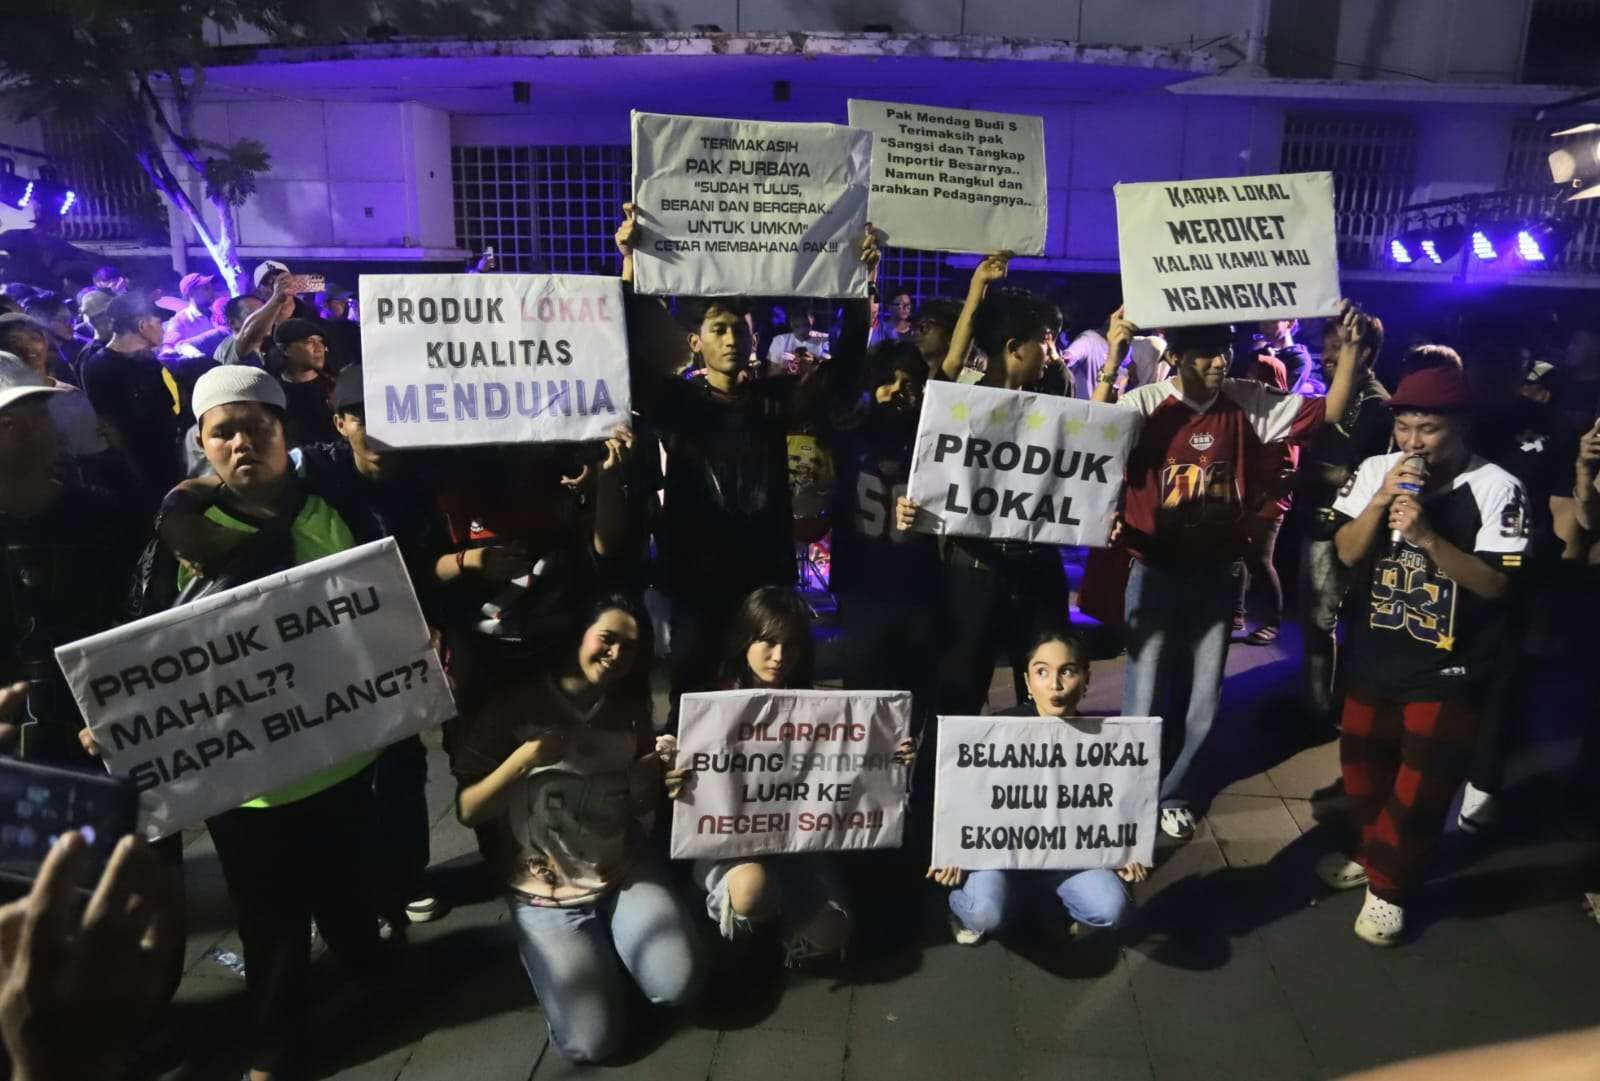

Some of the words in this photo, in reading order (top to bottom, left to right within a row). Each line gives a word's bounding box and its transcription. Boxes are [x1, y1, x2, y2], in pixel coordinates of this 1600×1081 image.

[887, 109, 912, 120] Pak
[917, 112, 970, 128] Mendag
[975, 119, 1004, 130] Budi
[1009, 122, 1017, 131] S
[701, 137, 798, 152] TERIMAKASIH
[899, 125, 974, 141] Terimaksih
[979, 134, 1003, 145] pak
[888, 153, 944, 167] Importir
[949, 159, 1019, 175] Besarnya..
[939, 144, 963, 155] dan
[968, 147, 1025, 163] Tangkap
[686, 159, 722, 174] PAK
[729, 161, 810, 177] PURBAYA
[886, 168, 934, 181] Namun
[939, 173, 994, 187] Rangkul
[999, 180, 1023, 190] dan
[754, 183, 801, 197] TULUS,
[872, 184, 928, 197] arahkan
[934, 187, 1031, 207] Pedagangnya..
[1232, 183, 1290, 201] LOKAL
[661, 200, 714, 211] BERANI
[719, 200, 748, 212] DAN
[754, 202, 832, 214] BERGERAK..
[688, 221, 744, 233] UNTUK
[1167, 215, 1284, 244] MEROKET
[655, 240, 700, 252] CETAR
[705, 241, 798, 253] MEMBAHANA
[803, 242, 838, 253] PAK!!!
[1153, 254, 1213, 273] KALAU
[1218, 251, 1268, 270] KAMU
[1270, 249, 1310, 266] MAU
[1162, 281, 1297, 312] NGANGKAT
[378, 297, 504, 324] PRODUK
[520, 296, 613, 323] LOKAL
[427, 340, 573, 368] KUALITAS
[385, 378, 616, 424] MENDUNIA
[934, 434, 1113, 483] PRODUK
[945, 483, 1080, 526] LOKAL
[89, 625, 268, 706] PRODUK
[275, 586, 380, 643] BARU
[110, 662, 295, 750] MAHAL??
[129, 728, 254, 791] SIAPA
[262, 659, 428, 743] BILANG??
[738, 723, 865, 742] DILARANG
[693, 753, 783, 773] BUANG
[957, 743, 1066, 768] BELANJA
[1076, 742, 1148, 767] LOKAL
[743, 783, 809, 802] LUAR
[819, 783, 851, 802] KE
[991, 784, 1047, 809] DULU
[1057, 783, 1113, 808] BIAR
[698, 812, 790, 834] NEGERI
[799, 811, 883, 831] SAYA!!!
[961, 826, 1066, 850] EKONOMI
[1075, 822, 1137, 849] MAJU
